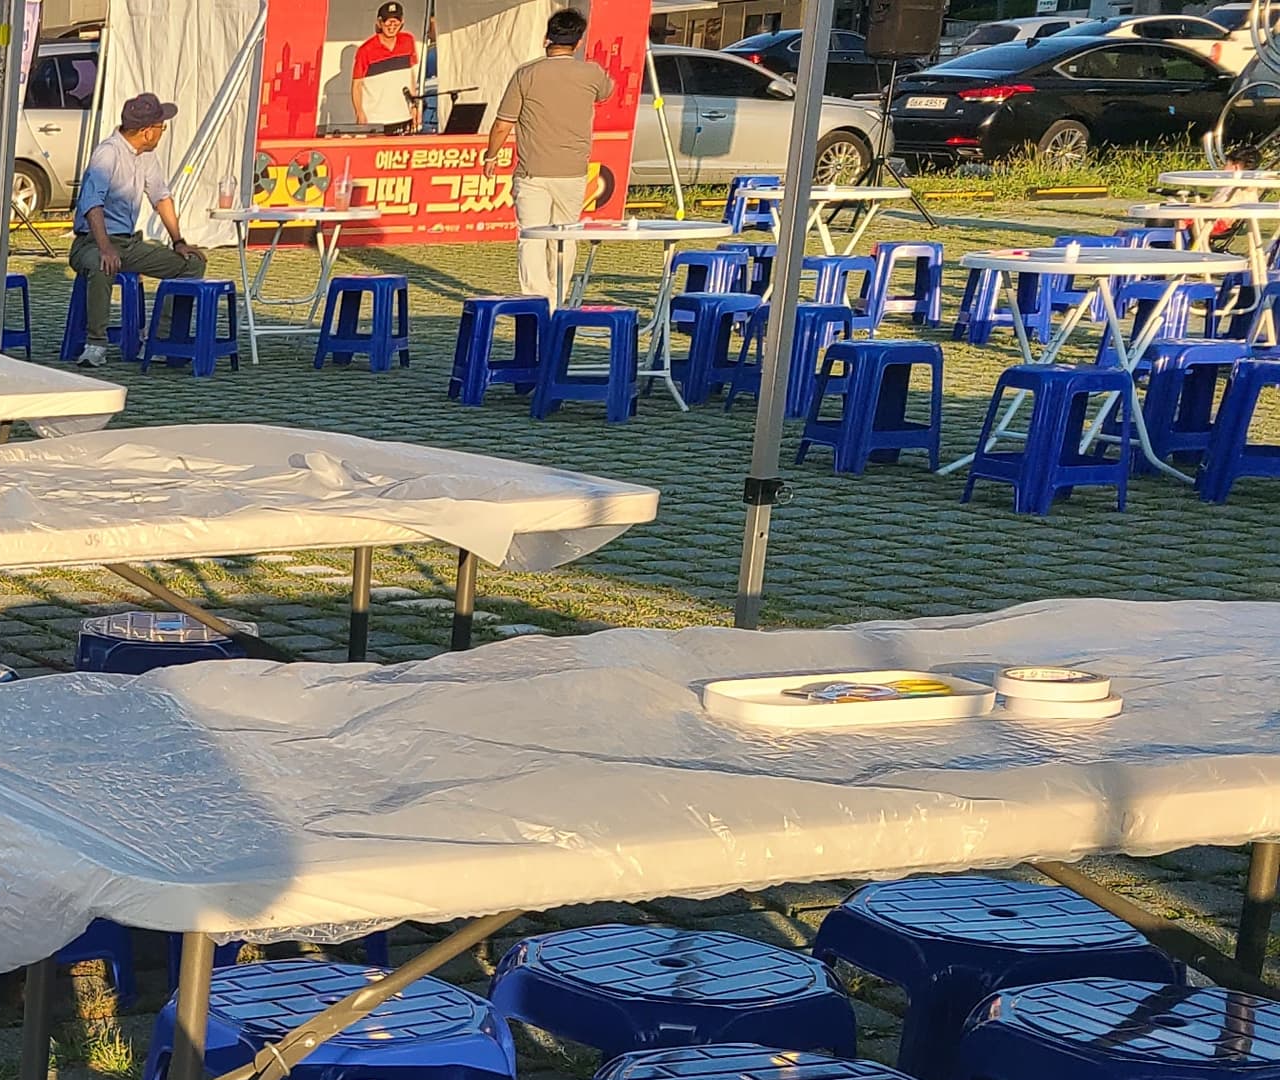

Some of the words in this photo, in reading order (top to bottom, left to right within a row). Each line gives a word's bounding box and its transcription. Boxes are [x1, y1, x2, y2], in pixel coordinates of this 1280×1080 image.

[375, 149, 410, 169] 예산
[412, 148, 476, 168] 문화유산
[479, 147, 513, 166] 행
